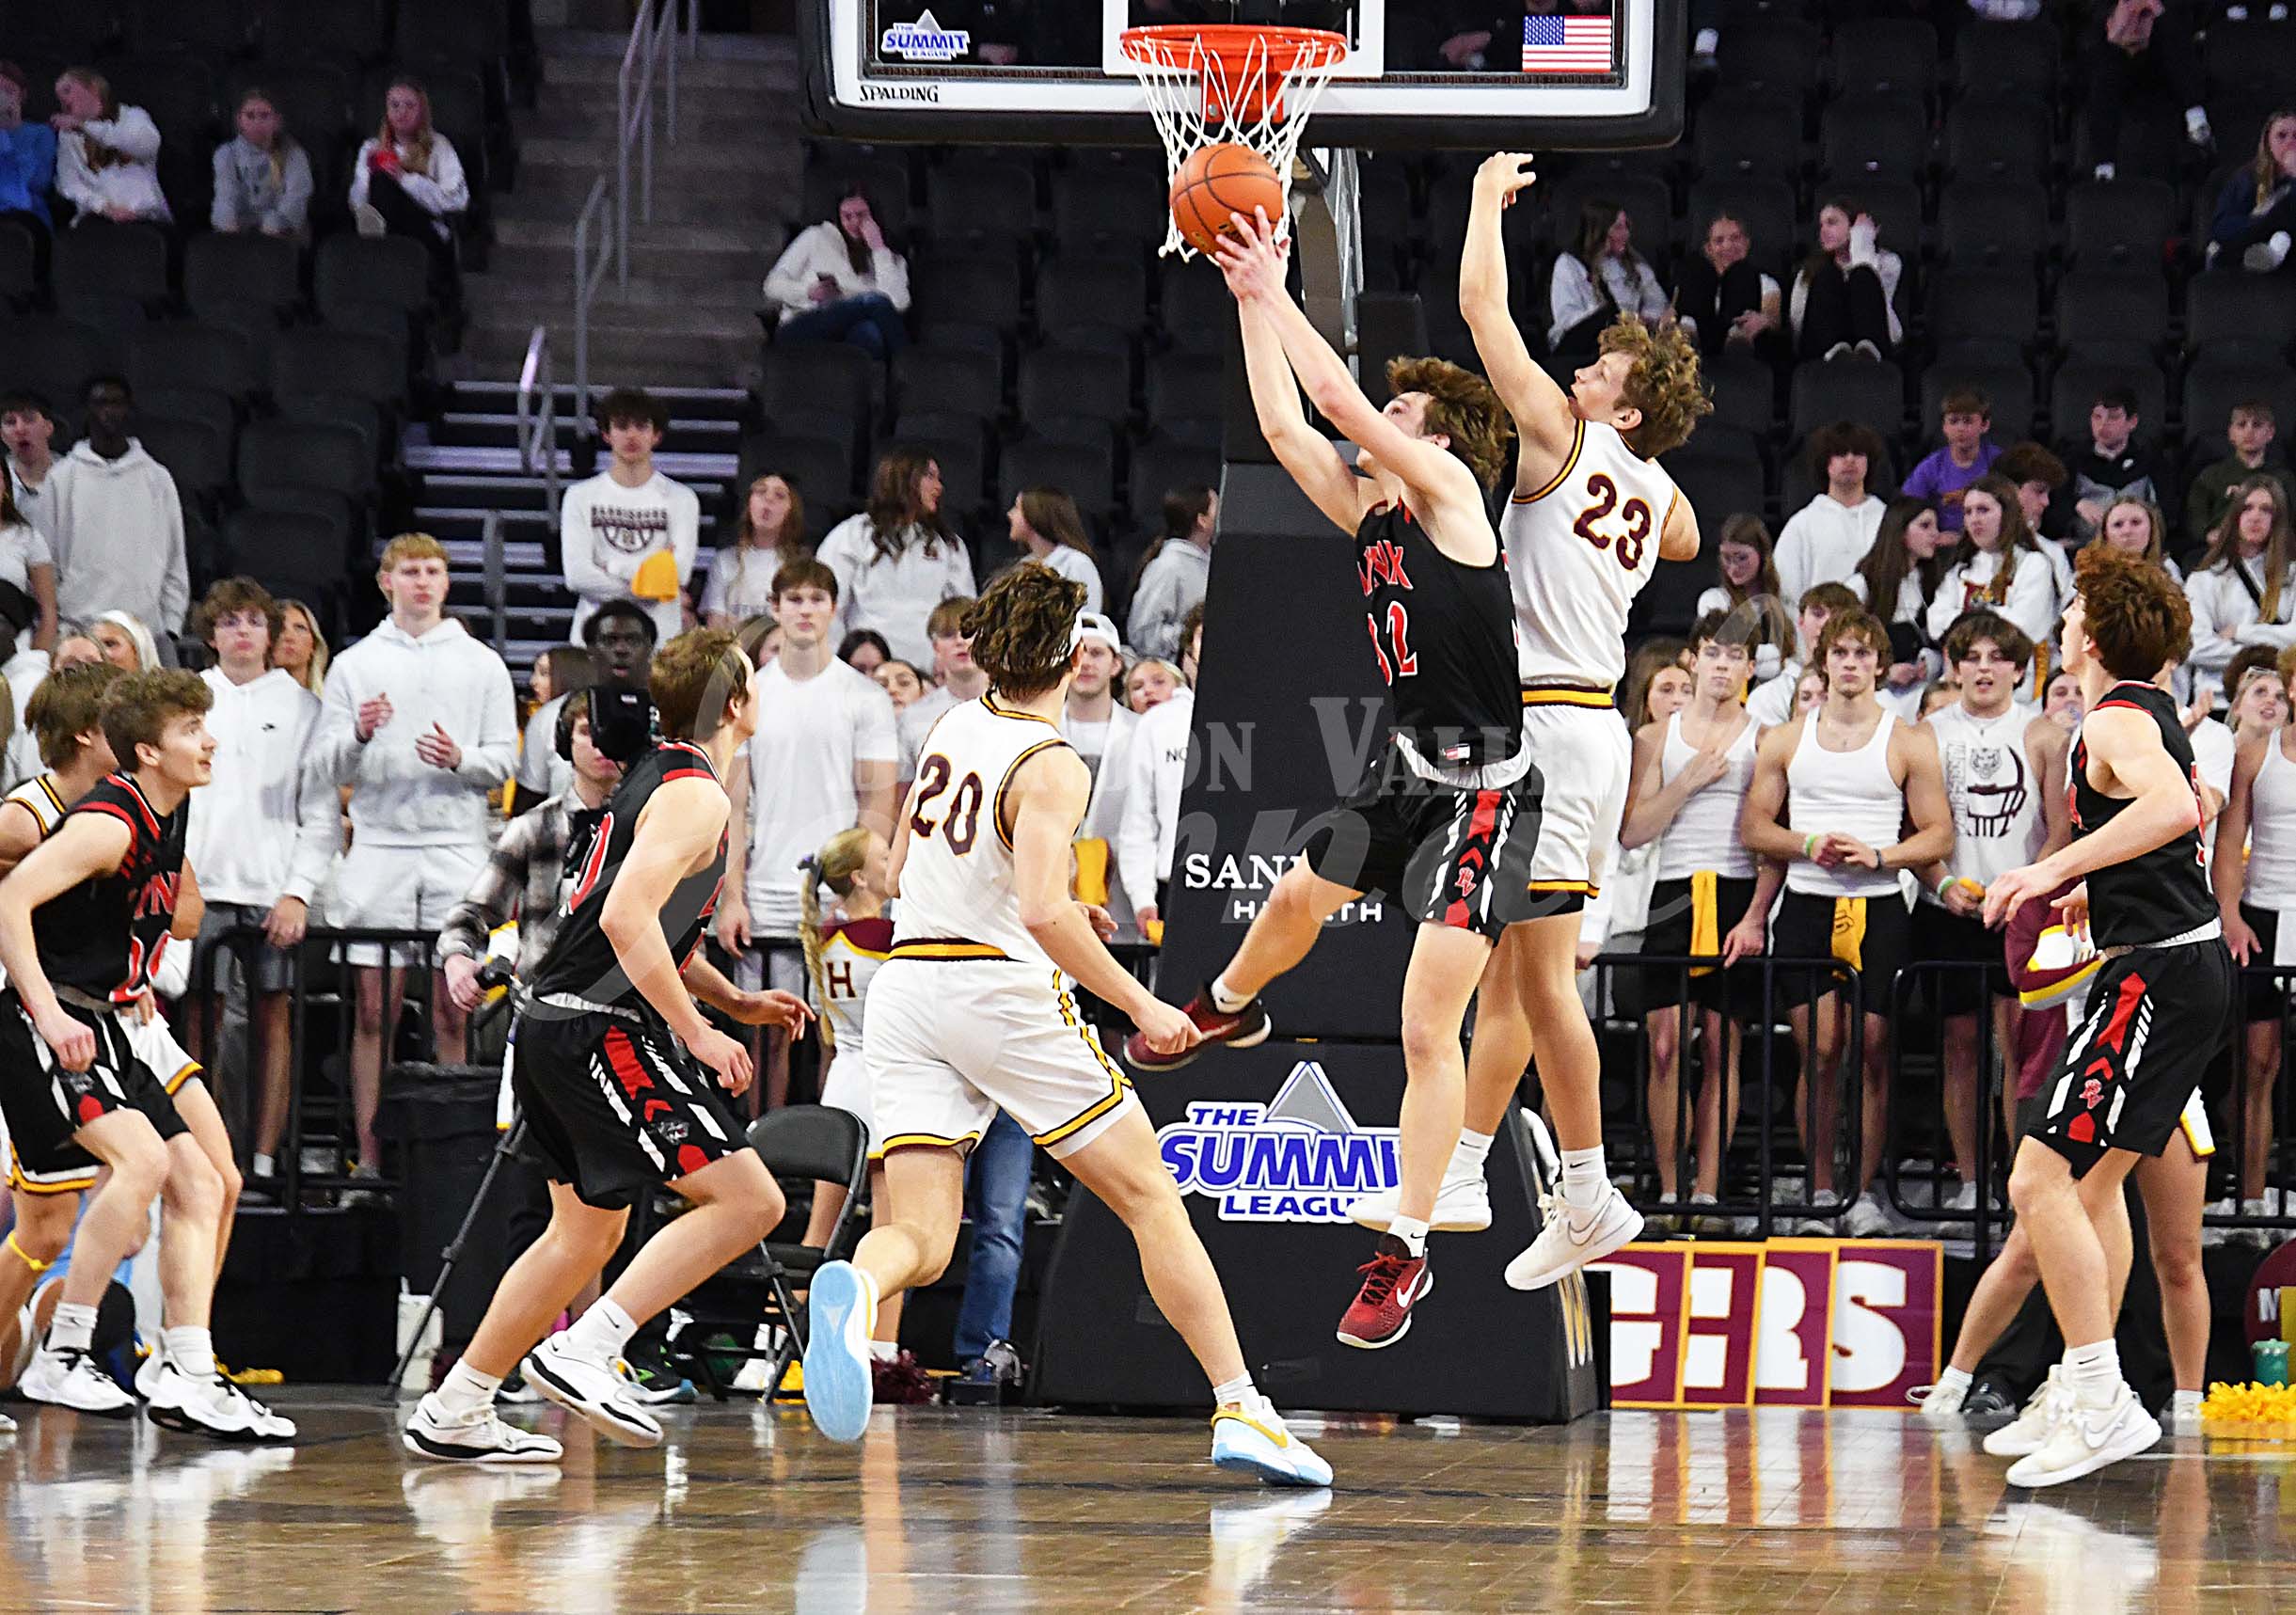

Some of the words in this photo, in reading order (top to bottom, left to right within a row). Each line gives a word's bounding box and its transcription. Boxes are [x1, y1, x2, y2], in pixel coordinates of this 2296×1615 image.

[886, 34, 965, 50] SUMMIT
[859, 85, 939, 103] SPALDING
[1573, 472, 1652, 571] 23
[910, 752, 984, 857] 20
[826, 959, 857, 999] H
[1191, 1107, 1259, 1126] THE
[1160, 1134, 1401, 1189] SUMMI
[1224, 1195, 1363, 1217] LEAGU
